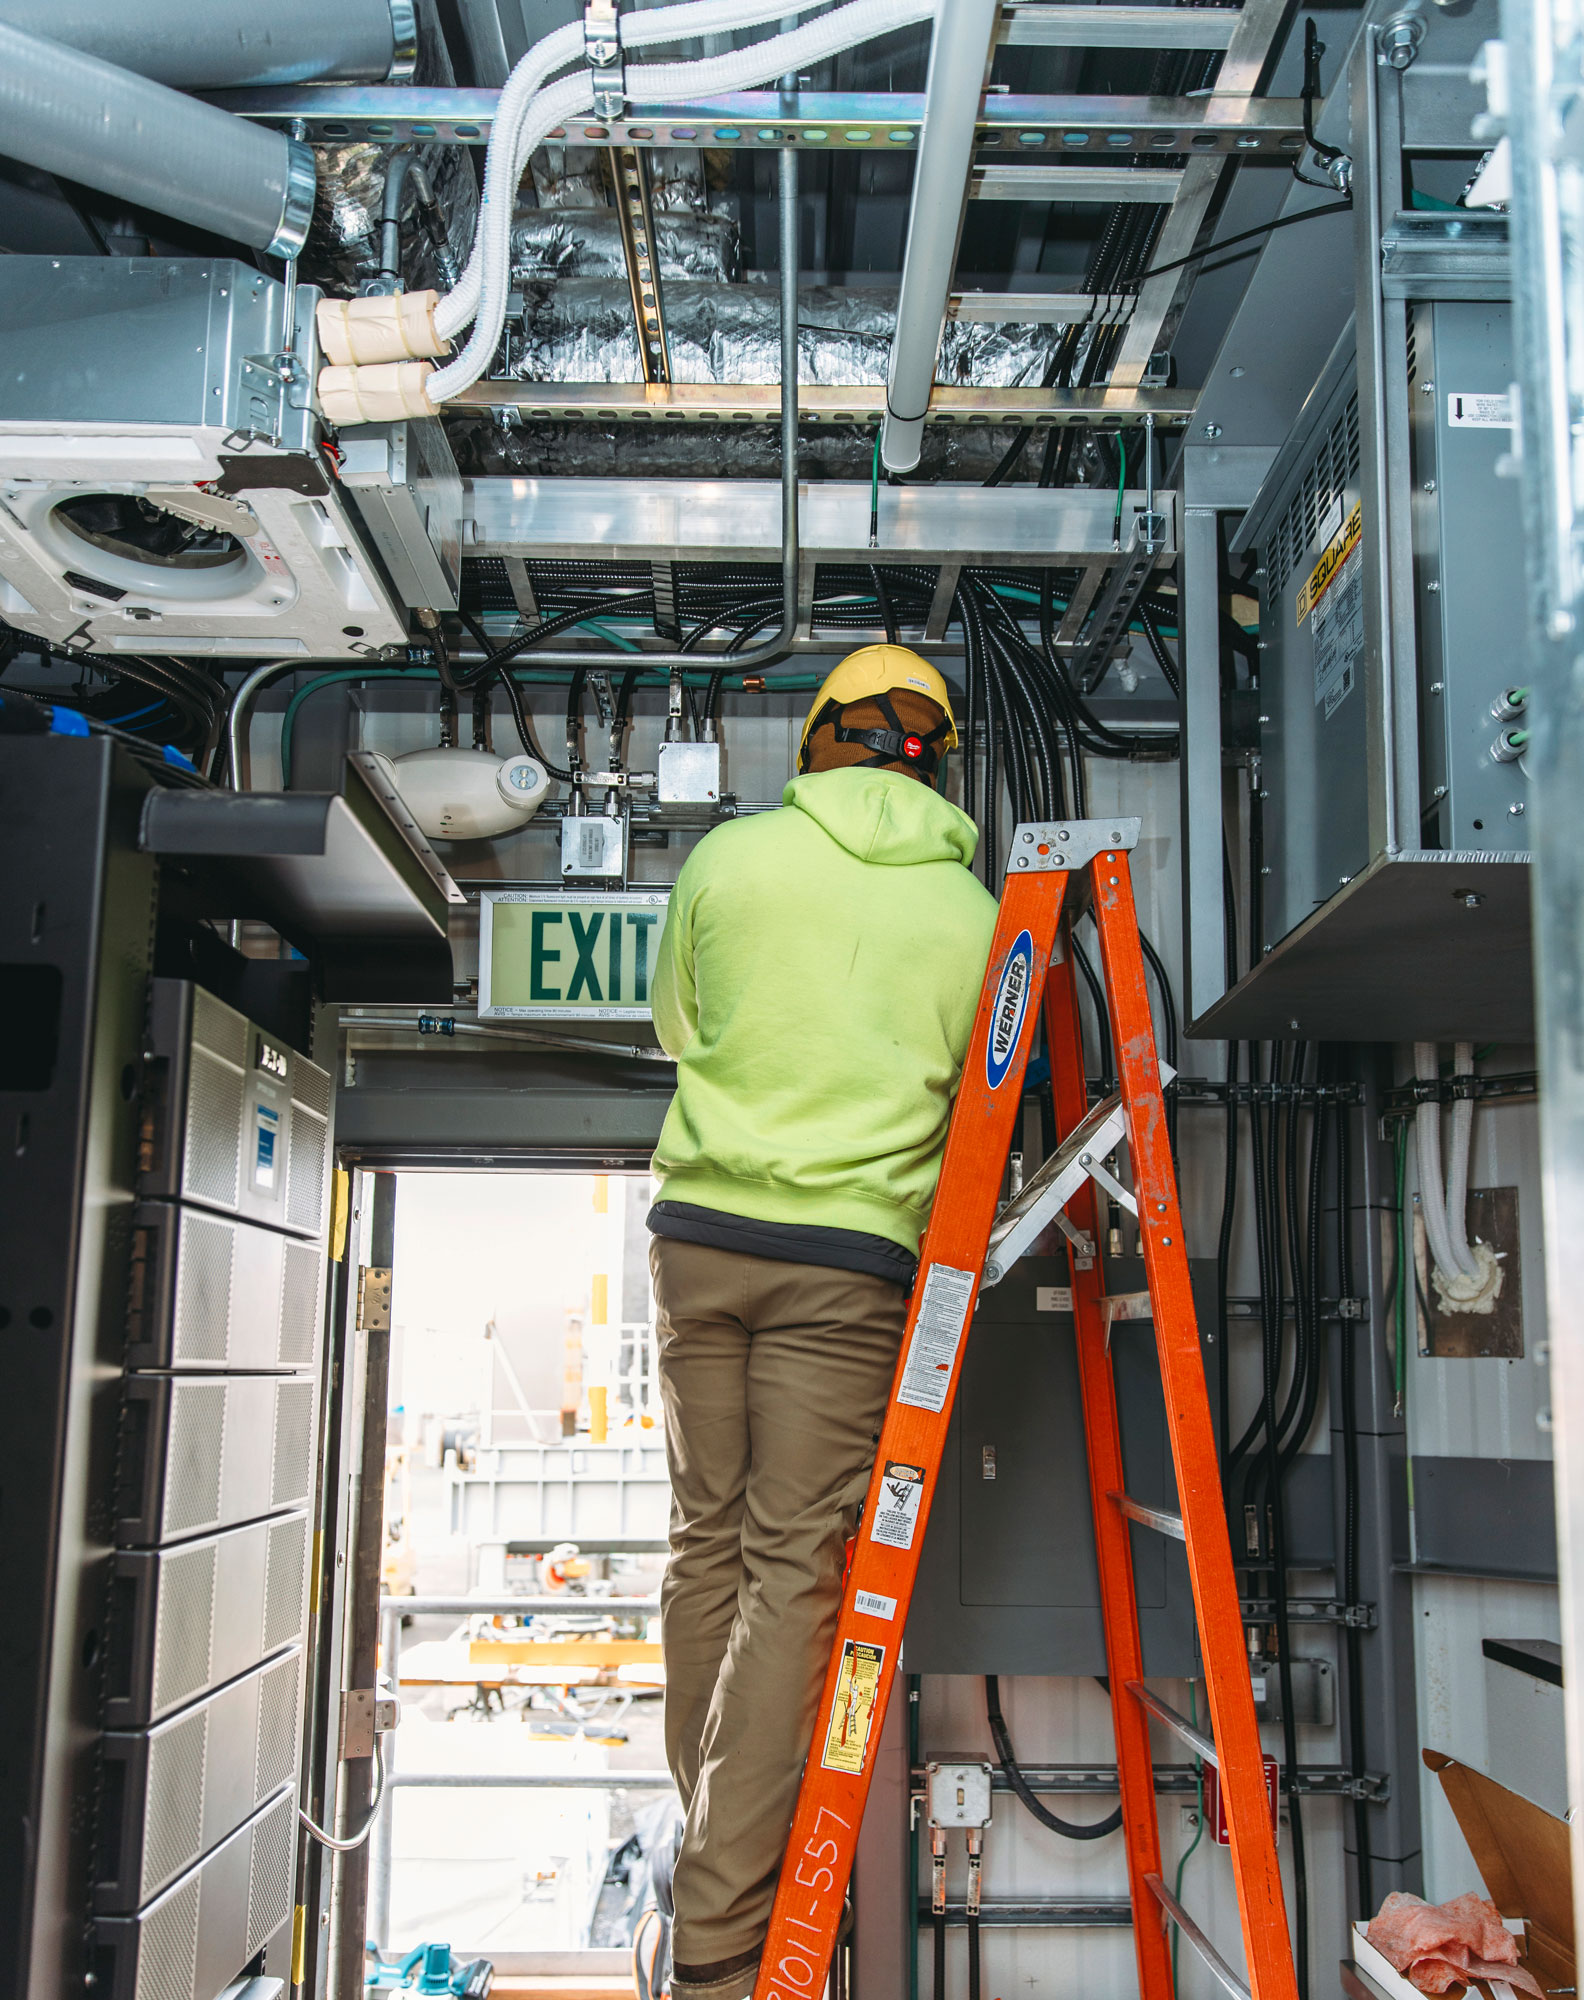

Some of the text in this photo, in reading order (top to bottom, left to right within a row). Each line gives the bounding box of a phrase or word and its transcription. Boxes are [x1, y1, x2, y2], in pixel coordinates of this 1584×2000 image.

[1310, 507, 1361, 599] SQUARE
[530, 911, 658, 1001] EXIT
[994, 961, 1025, 1054] WERNER
